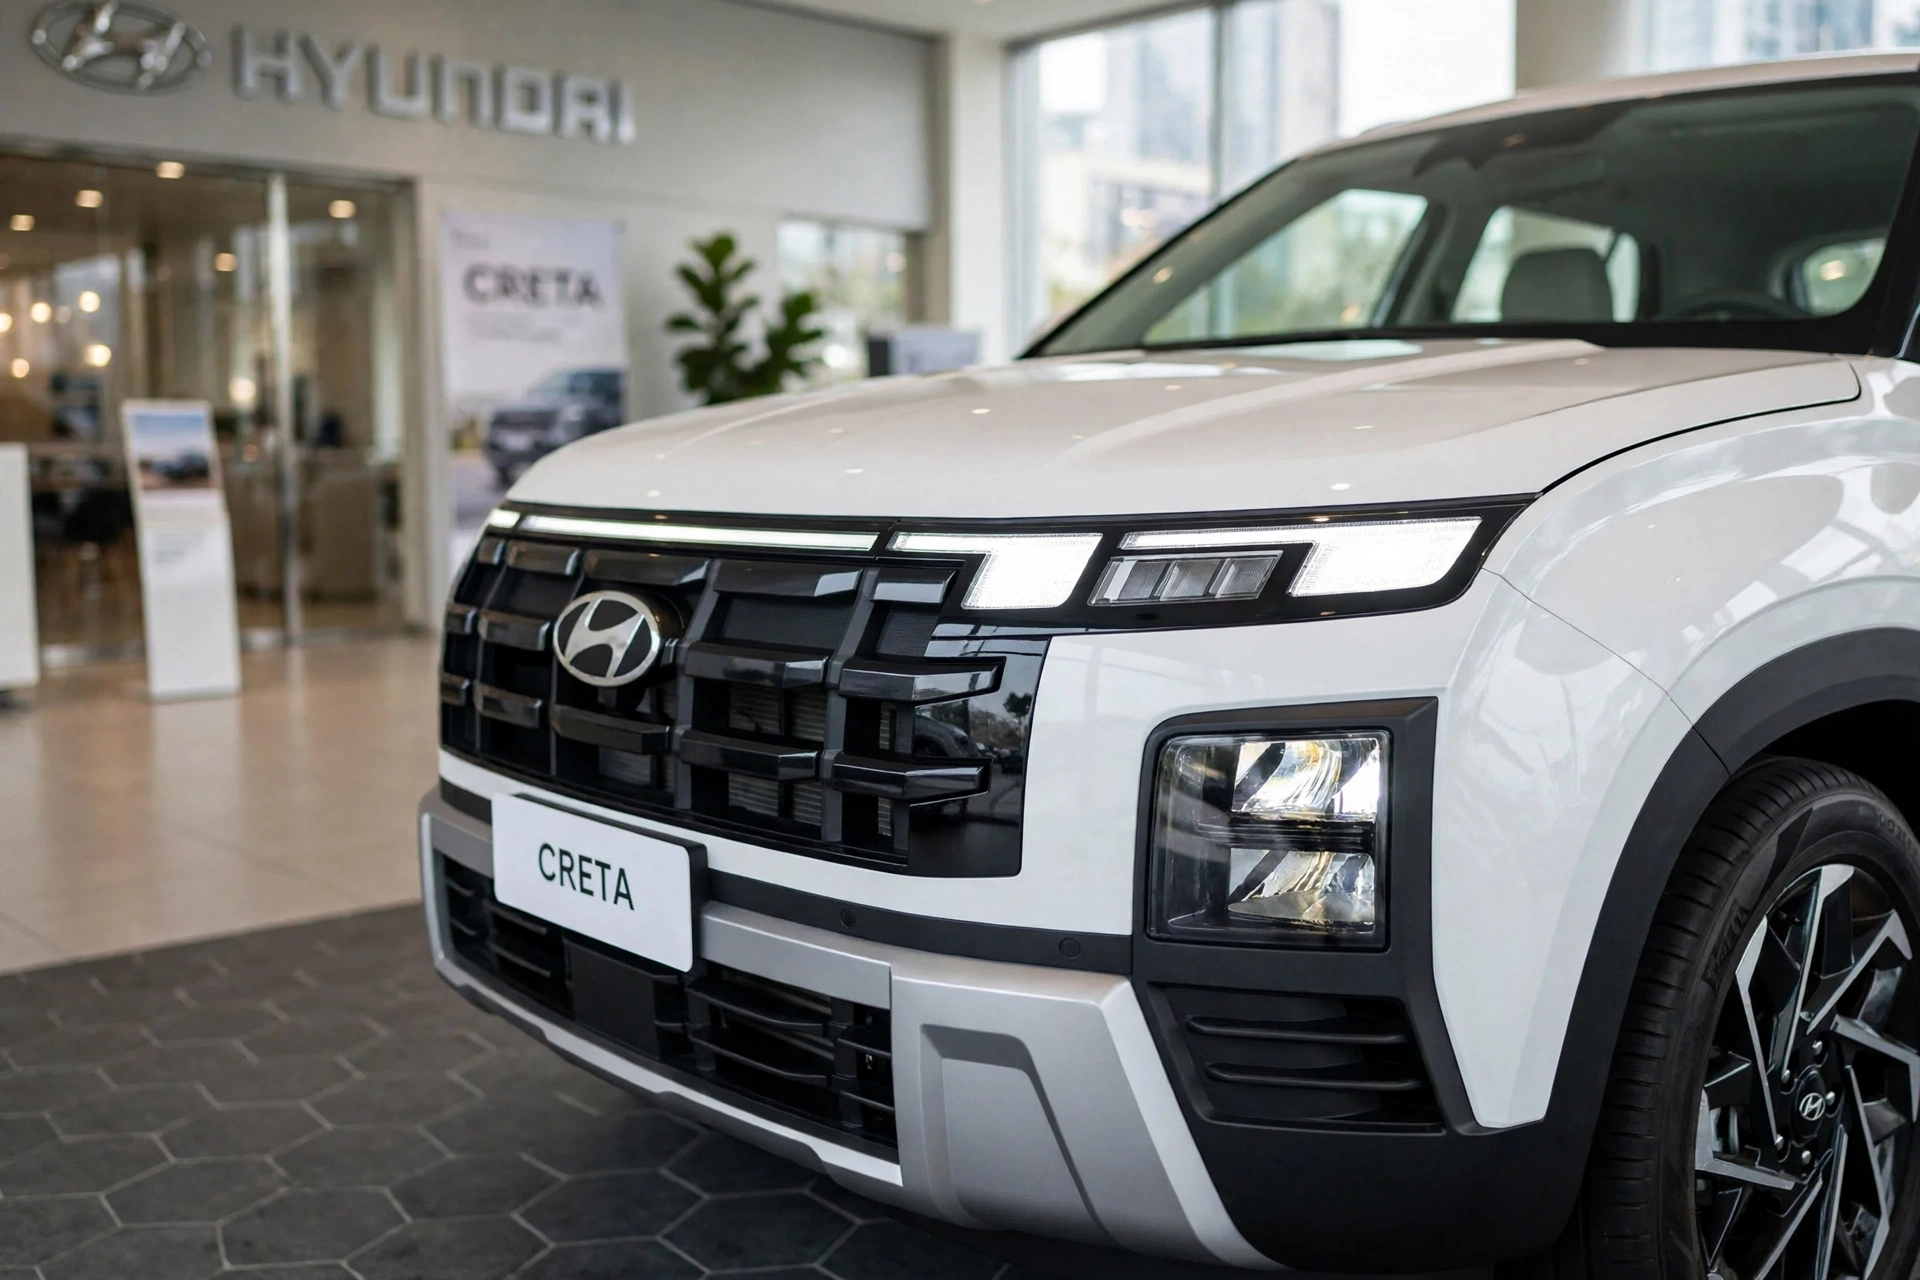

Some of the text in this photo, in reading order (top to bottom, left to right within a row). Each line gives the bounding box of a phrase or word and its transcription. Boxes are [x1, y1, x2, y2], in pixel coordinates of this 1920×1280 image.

[234, 24, 635, 143] HYUNDAI
[464, 264, 603, 309] CRETA
[538, 842, 634, 911] CRETA
